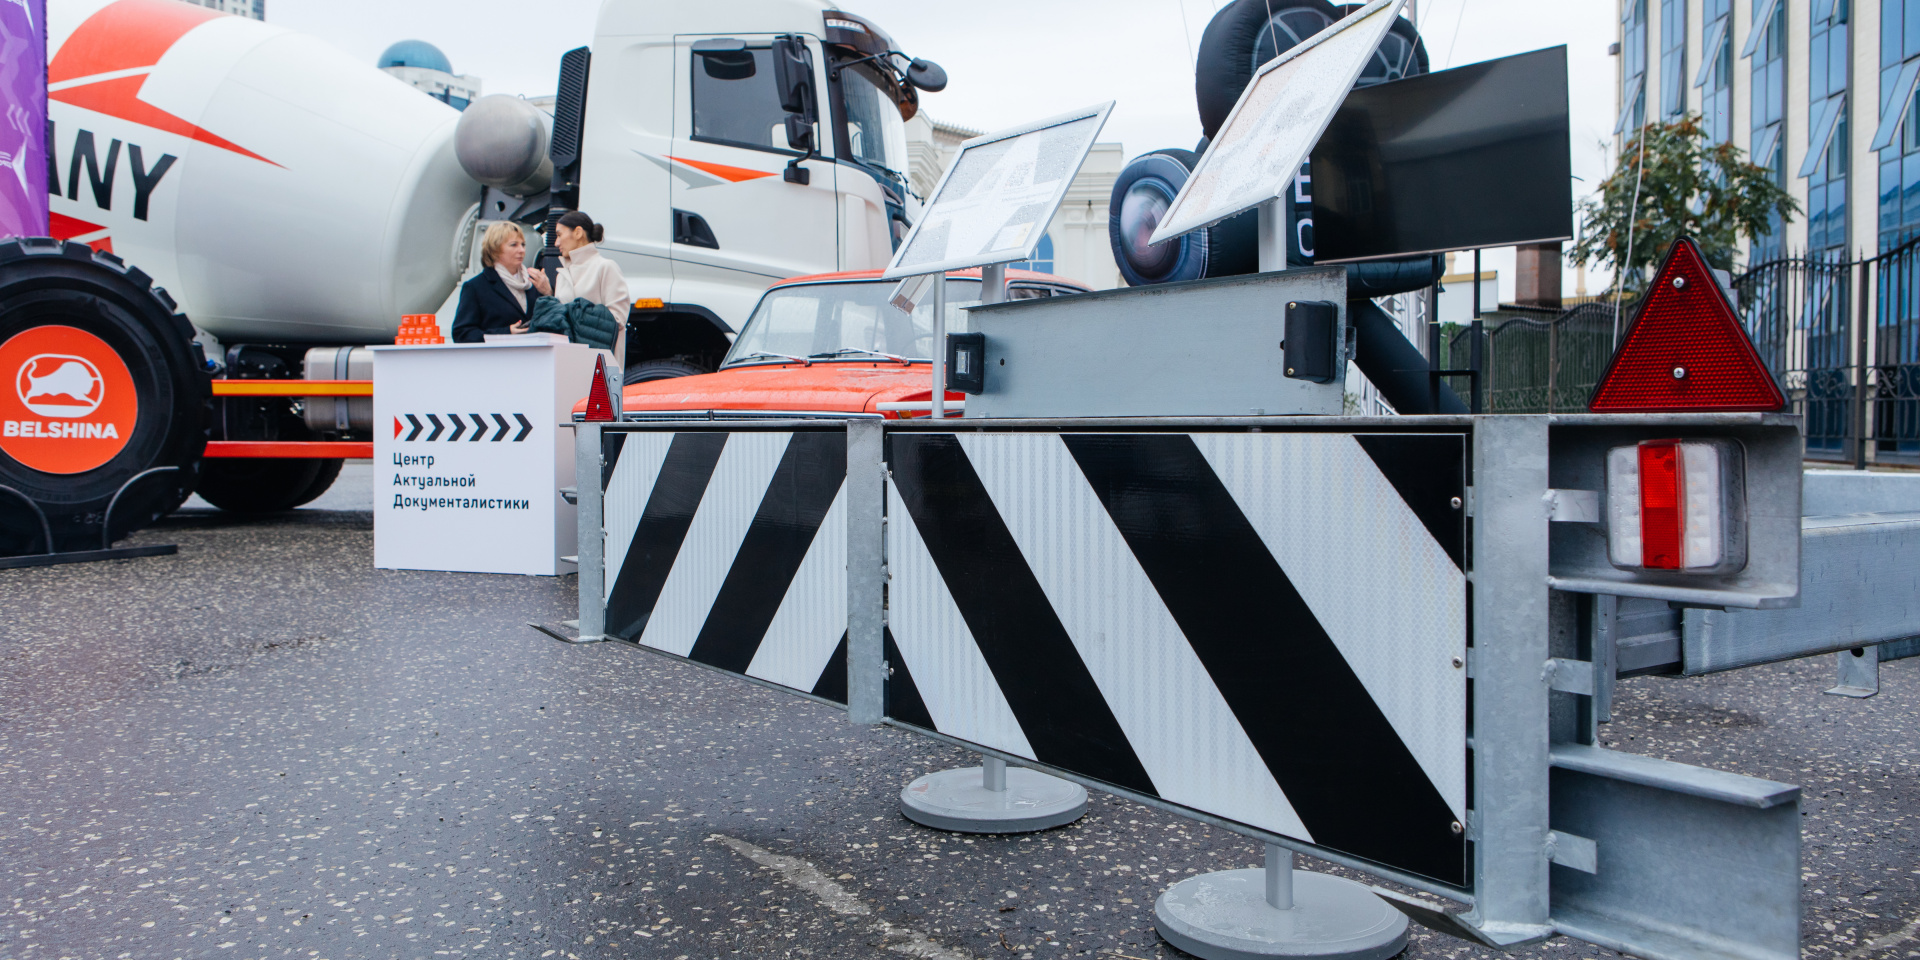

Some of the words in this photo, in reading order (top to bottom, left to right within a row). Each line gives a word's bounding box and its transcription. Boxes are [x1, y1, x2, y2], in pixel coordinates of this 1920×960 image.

[3, 420, 119, 439] BELSHINA
[393, 452, 435, 469] Центр
[393, 473, 476, 490] Актуальной
[393, 493, 530, 511] Документалистики
